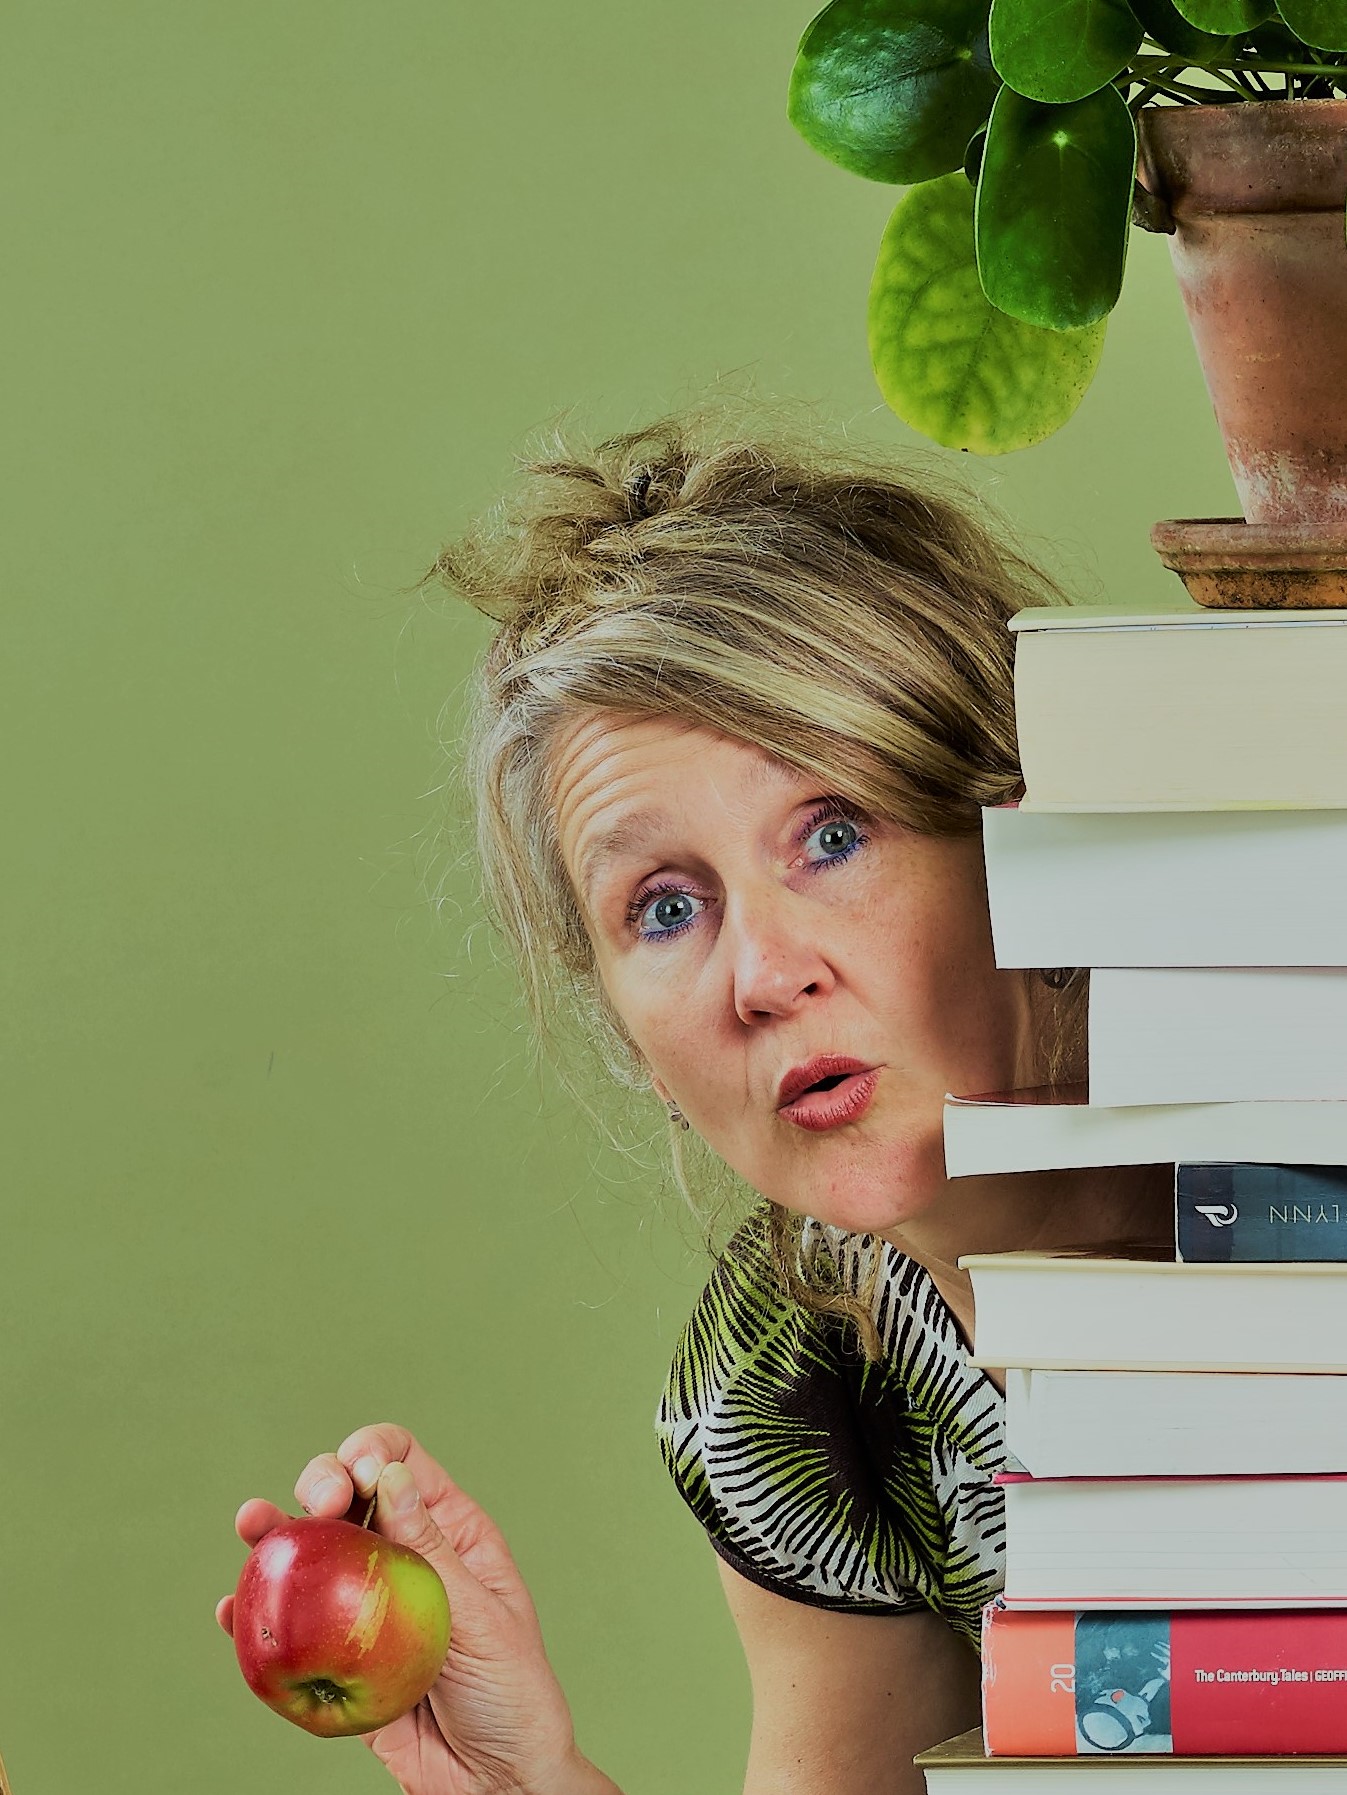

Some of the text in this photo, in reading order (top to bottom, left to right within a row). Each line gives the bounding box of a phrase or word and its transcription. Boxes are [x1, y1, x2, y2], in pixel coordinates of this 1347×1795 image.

[1269, 1204, 1347, 1224] LYNN
[1050, 1664, 1076, 1693] 20
[1194, 1669, 1215, 1683] The
[1216, 1668, 1279, 1686] Canterbury
[1280, 1668, 1309, 1683] Tales
